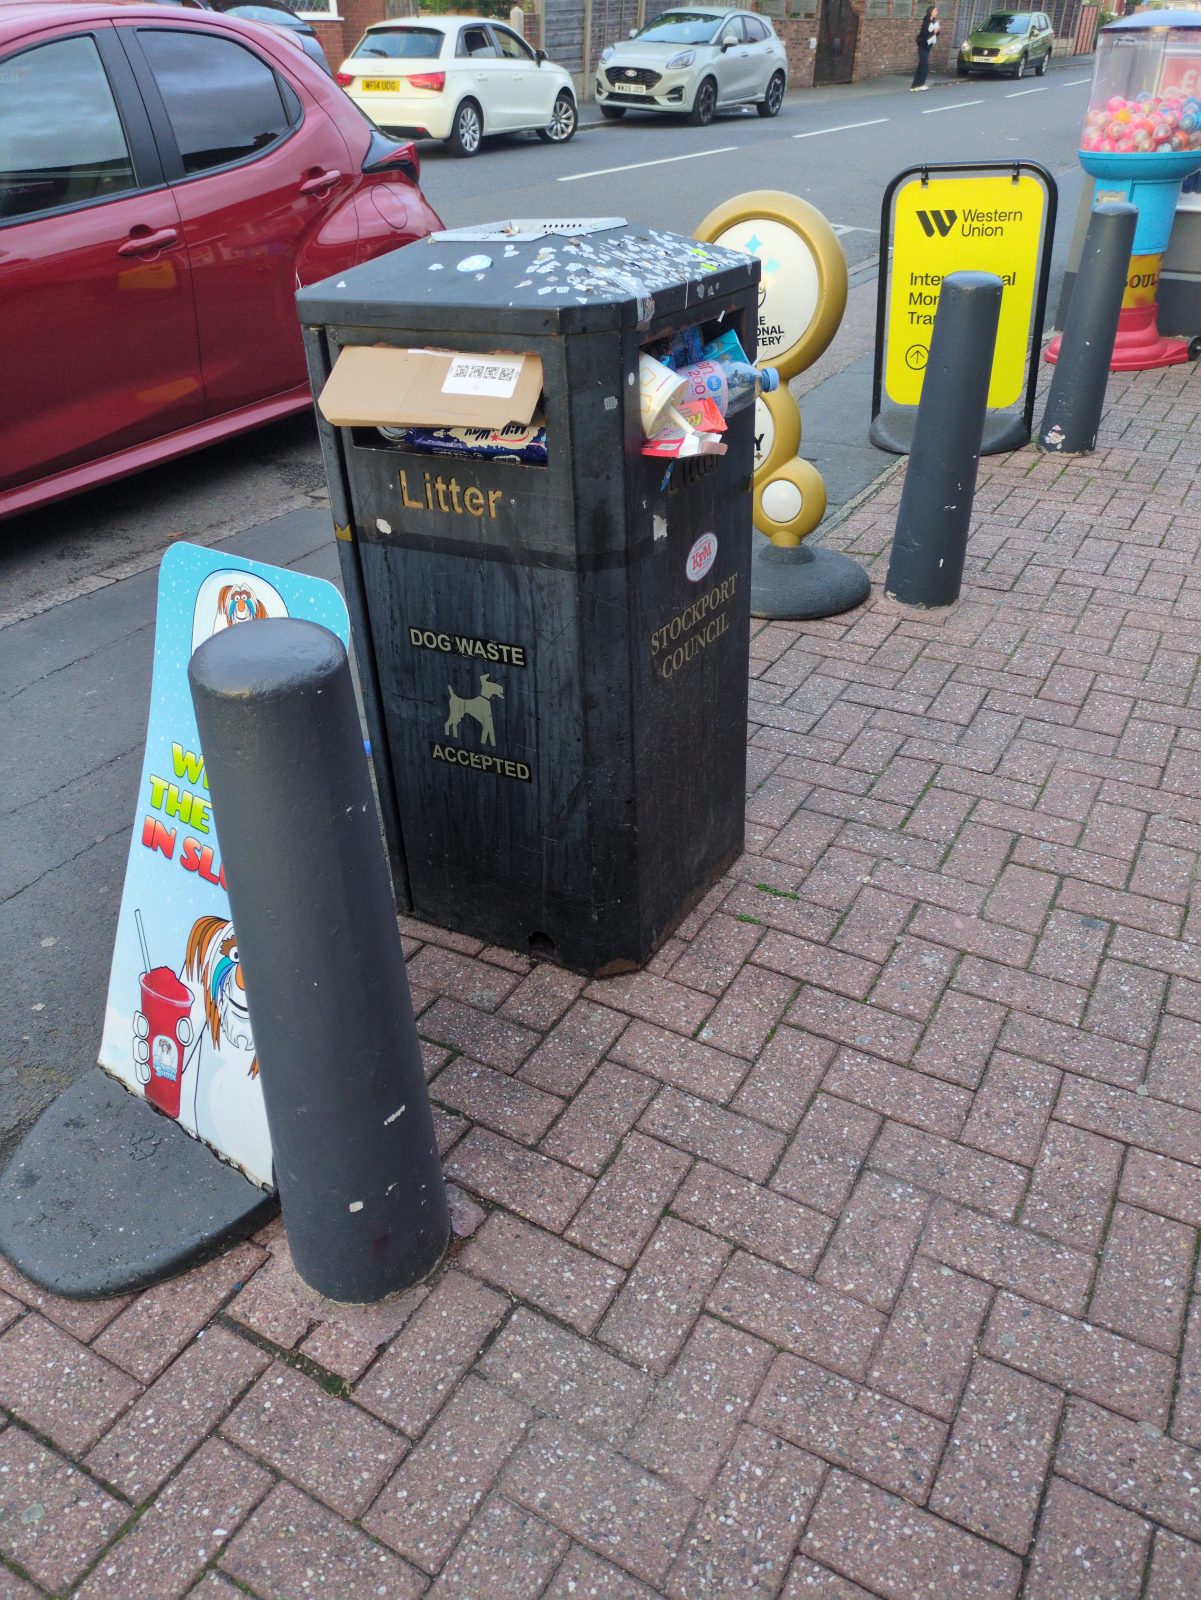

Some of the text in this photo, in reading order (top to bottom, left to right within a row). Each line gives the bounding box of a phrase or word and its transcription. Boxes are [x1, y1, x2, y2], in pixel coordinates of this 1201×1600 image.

[961, 223, 1004, 237] Union
[962, 208, 1023, 223] Western
[399, 470, 503, 518] Litter
[651, 573, 738, 656] STOCKPORT
[410, 628, 525, 666] DOG WASTE
[662, 612, 730, 679] COUNCIL
[432, 744, 530, 780] ACCEPTED
[141, 815, 177, 860] IN
